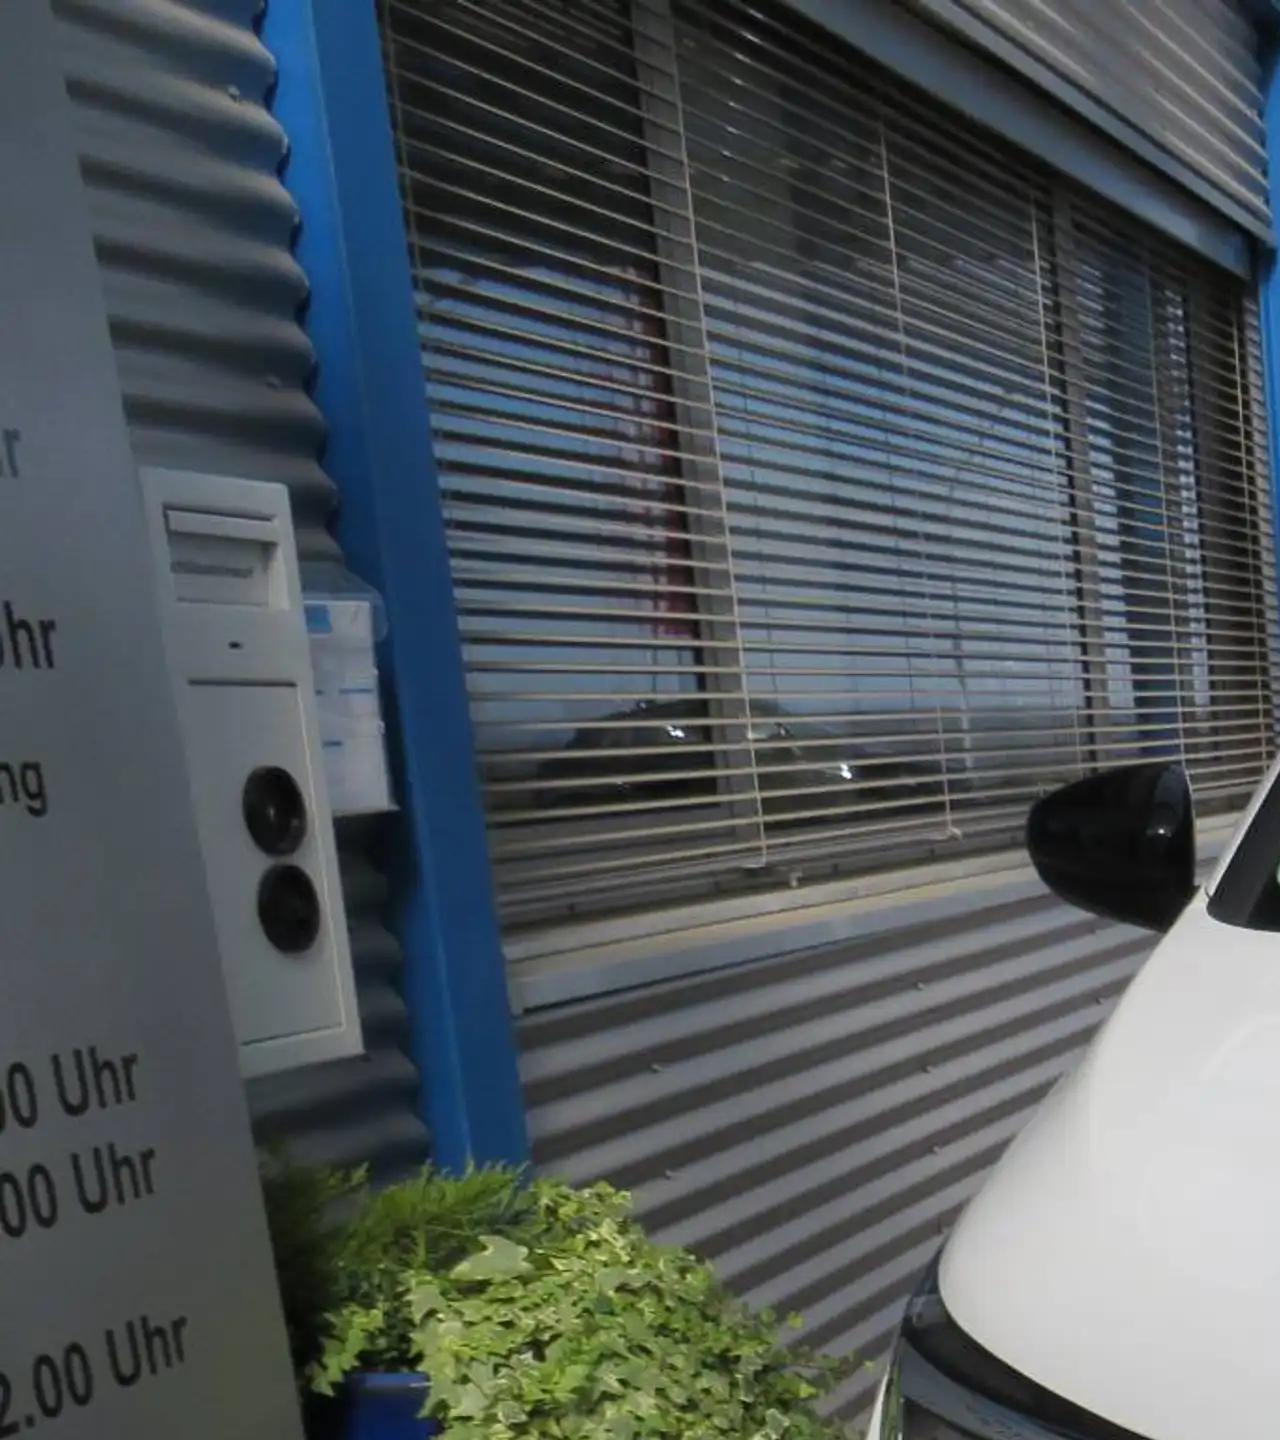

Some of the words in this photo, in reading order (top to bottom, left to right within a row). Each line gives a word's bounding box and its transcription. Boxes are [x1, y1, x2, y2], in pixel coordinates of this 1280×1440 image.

[0, 602, 56, 670] hr
[0, 1061, 38, 1136] 0
[50, 1046, 138, 1117] Uhr
[70, 1142, 156, 1214] Uhr
[105, 1315, 187, 1387] Uhr
